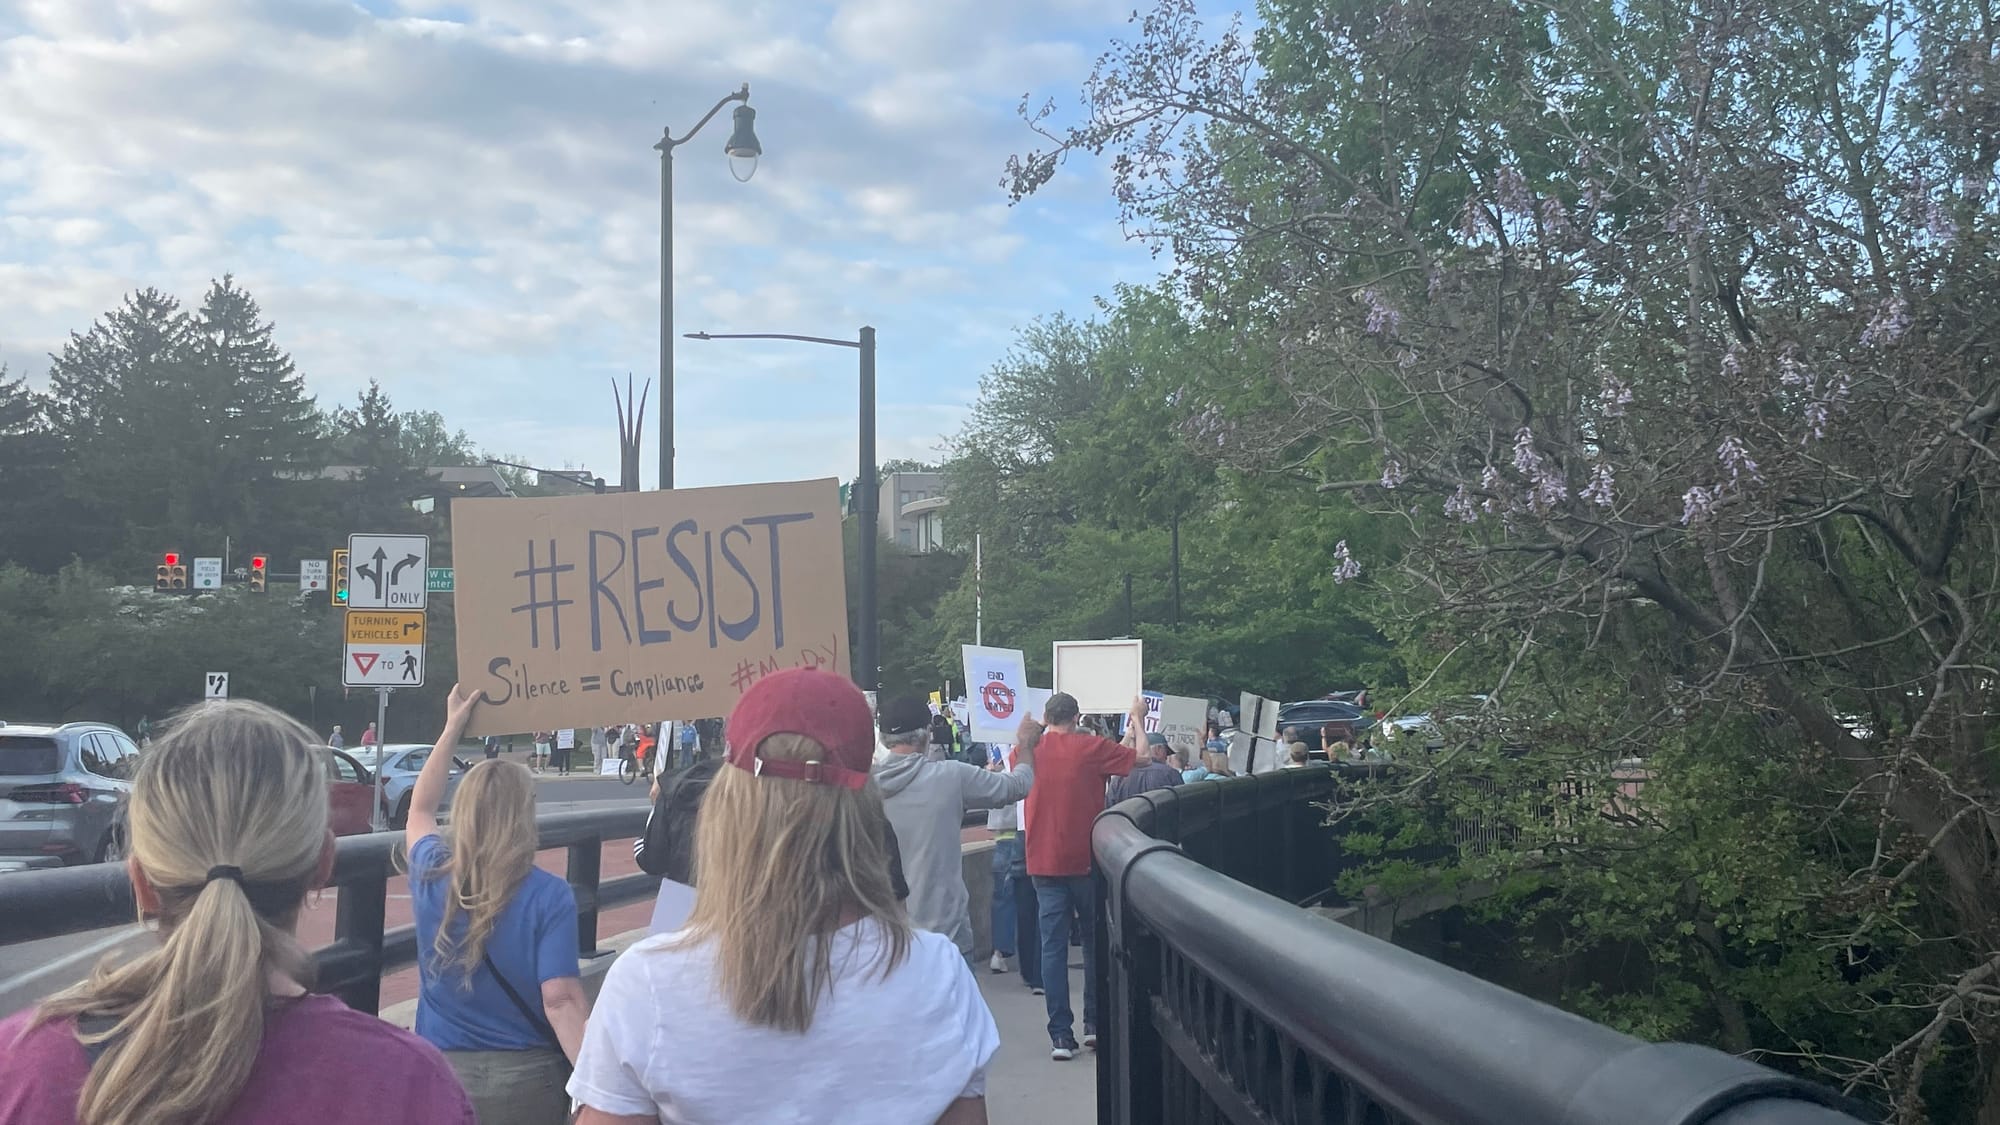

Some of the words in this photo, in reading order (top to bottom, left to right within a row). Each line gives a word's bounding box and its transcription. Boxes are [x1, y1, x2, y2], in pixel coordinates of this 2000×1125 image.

[429, 570, 439, 578] W
[511, 512, 814, 651] #RESIST
[391, 592, 420, 604] ONLY
[353, 616, 399, 626] TURNING
[351, 630, 399, 640] VEHICLES
[381, 661, 394, 670] TO
[480, 656, 570, 705] Silence
[610, 669, 704, 701] Compliance
[987, 671, 1005, 681] END
